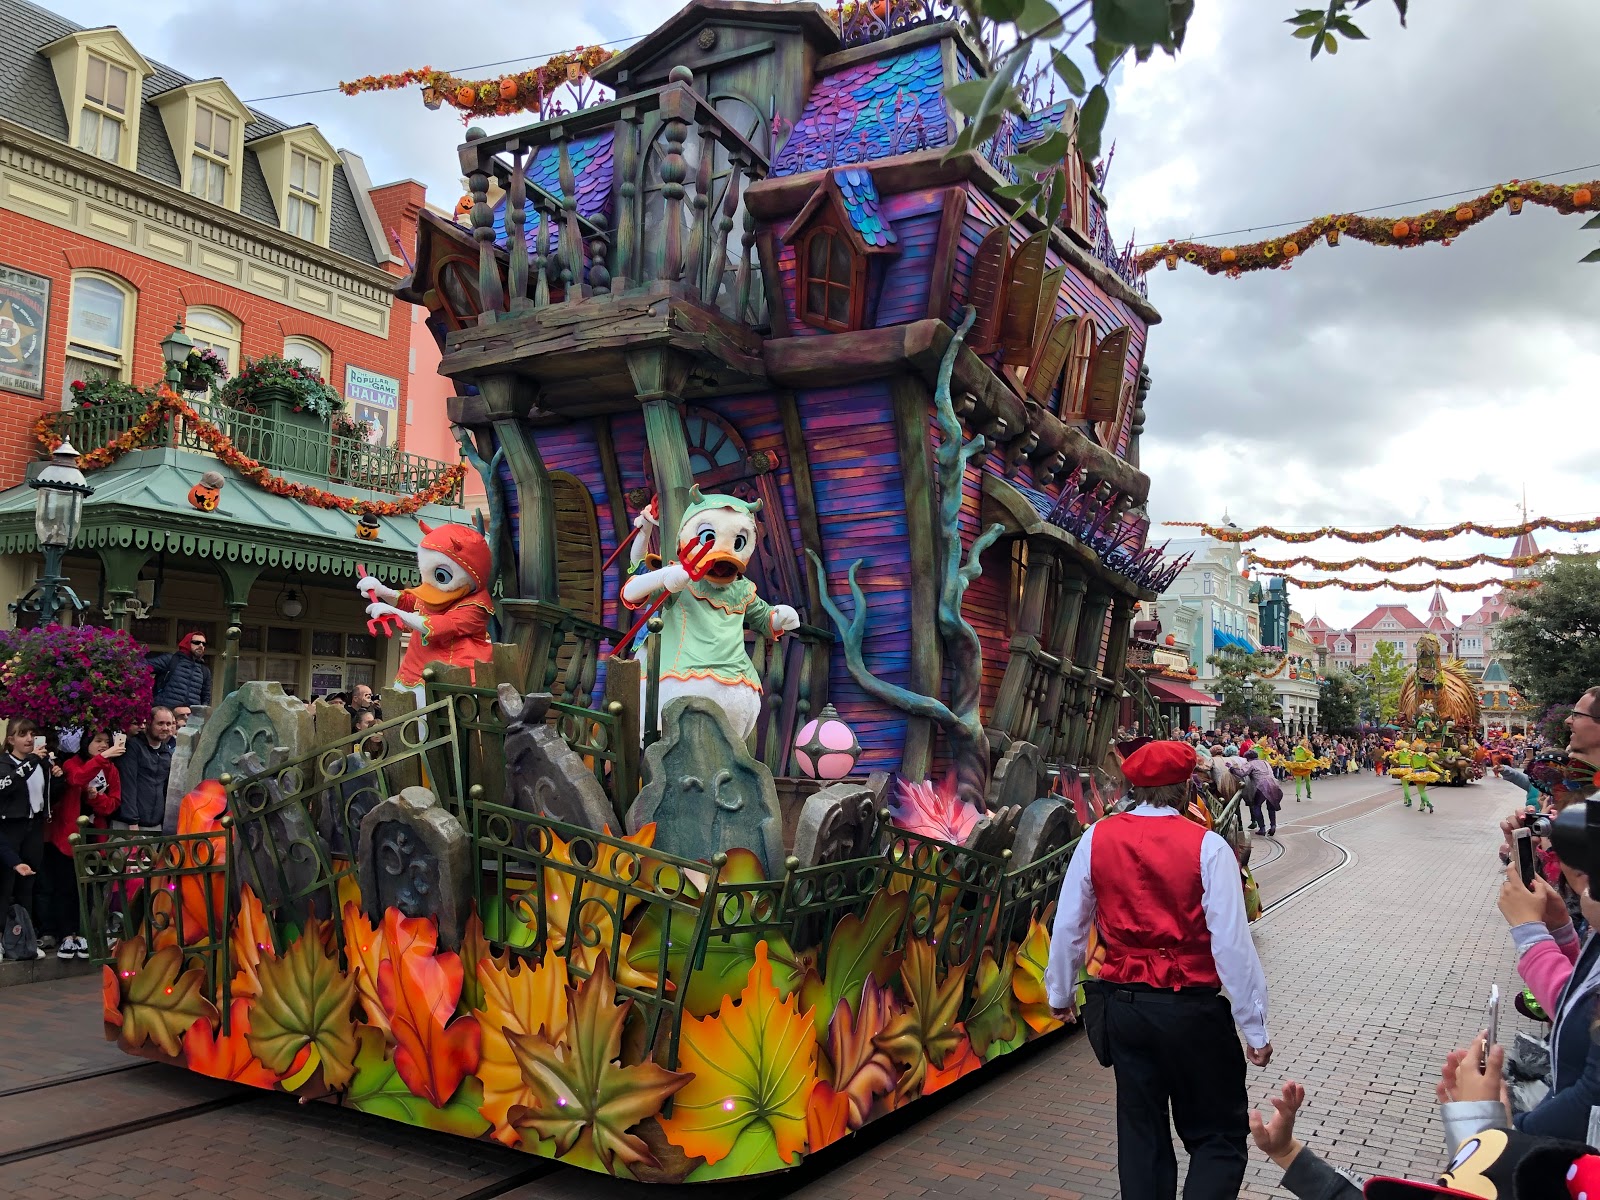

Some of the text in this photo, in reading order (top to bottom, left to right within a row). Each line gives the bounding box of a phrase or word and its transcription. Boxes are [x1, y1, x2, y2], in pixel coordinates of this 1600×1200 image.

[351, 369, 389, 386] POPULAR
[350, 384, 395, 408] HALMA
[372, 382, 396, 395] GAME
